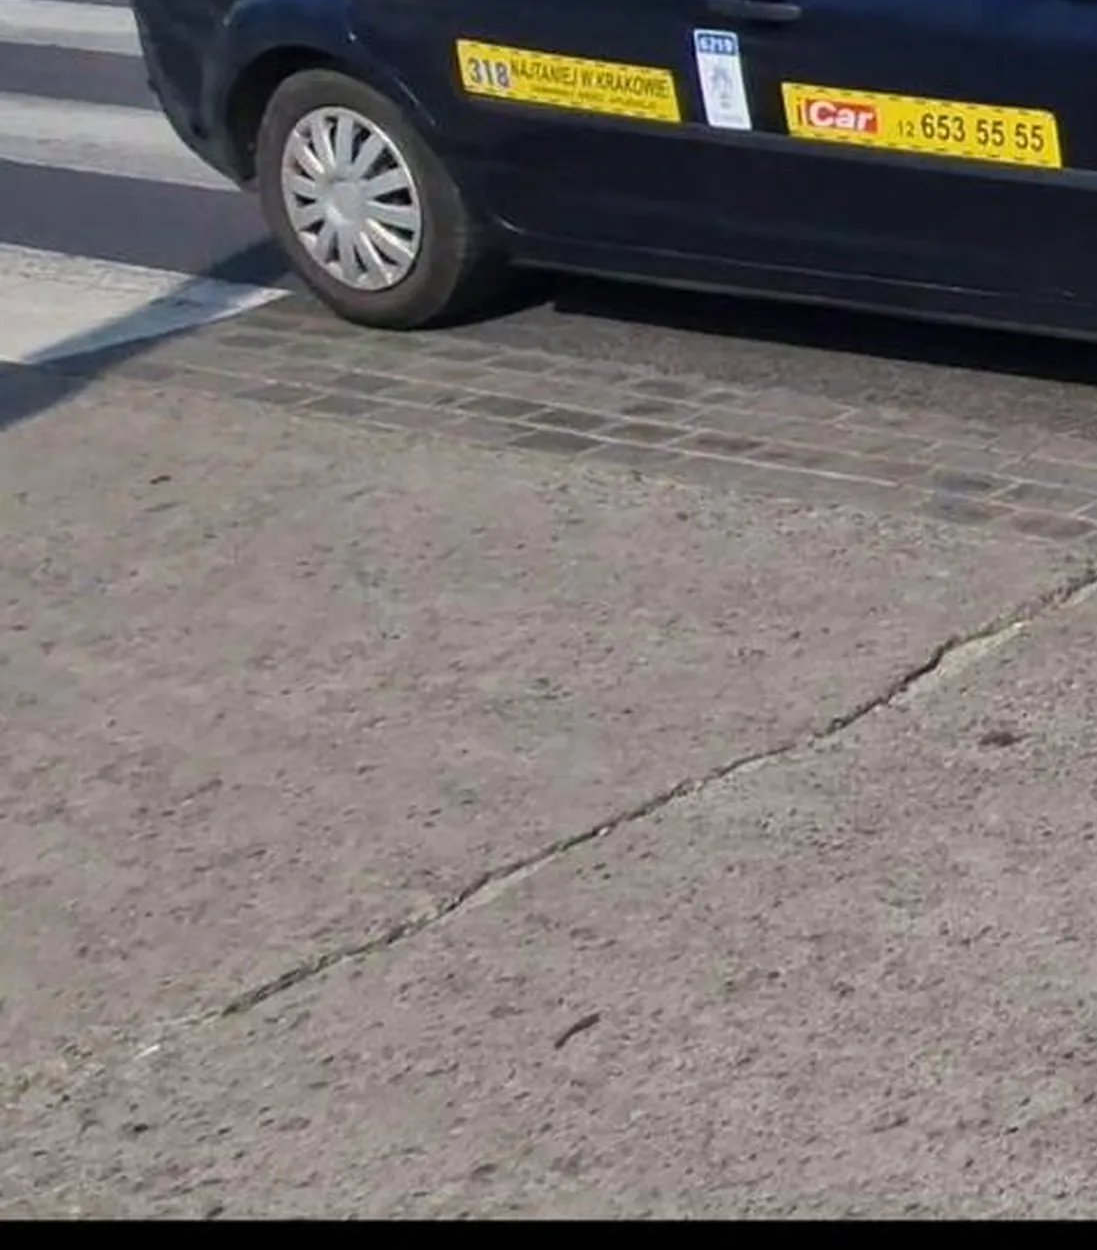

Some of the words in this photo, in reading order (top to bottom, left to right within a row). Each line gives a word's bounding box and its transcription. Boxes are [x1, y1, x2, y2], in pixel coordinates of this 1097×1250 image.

[469, 57, 511, 89] 318
[511, 58, 577, 87] NAJTANIEJ
[898, 119, 915, 139] 12
[921, 112, 966, 144] 653
[975, 118, 1006, 147] 55
[1014, 122, 1045, 153] 55
